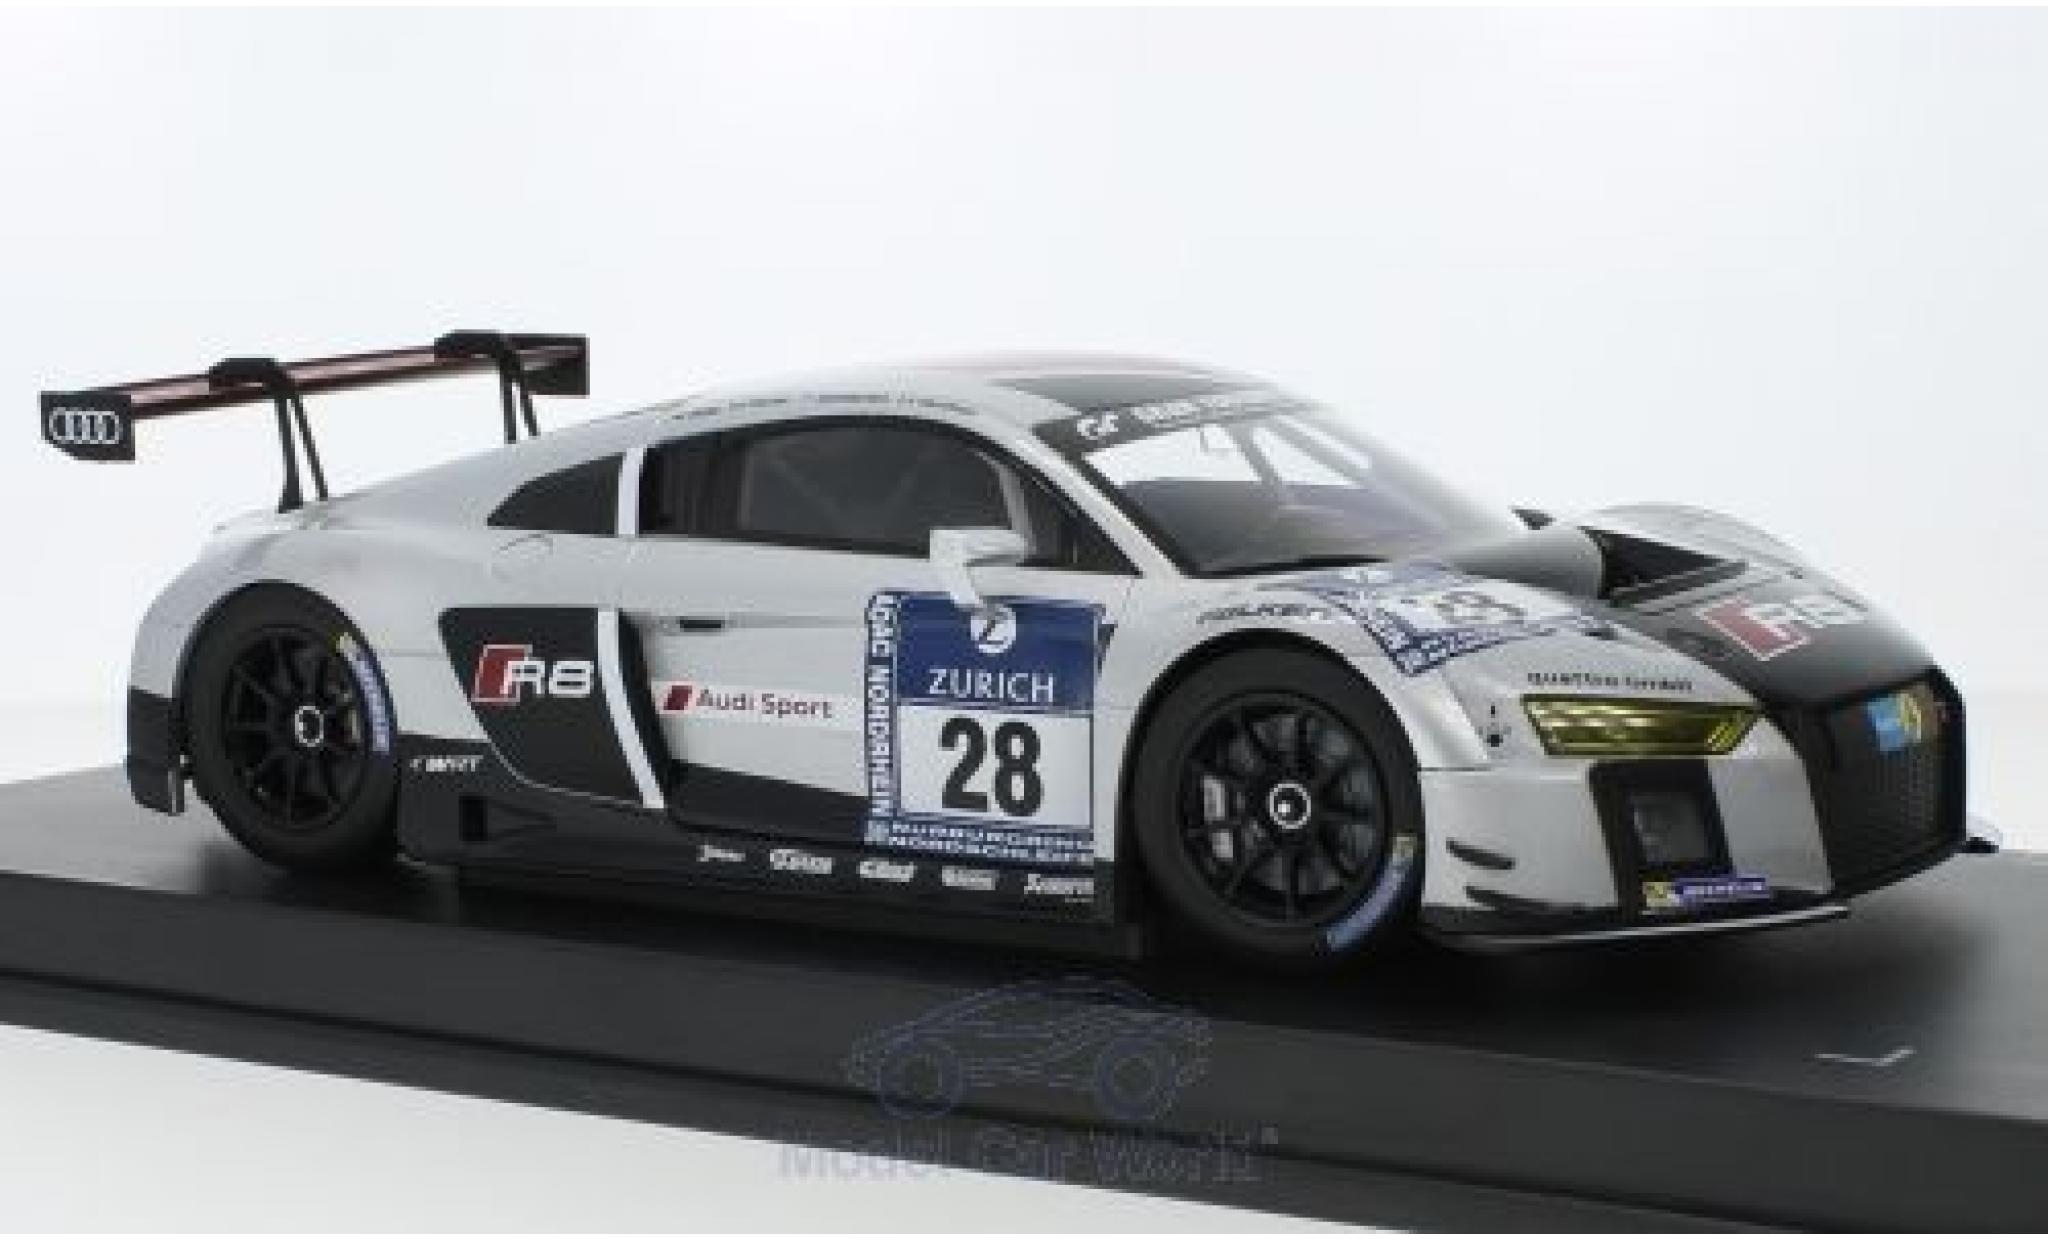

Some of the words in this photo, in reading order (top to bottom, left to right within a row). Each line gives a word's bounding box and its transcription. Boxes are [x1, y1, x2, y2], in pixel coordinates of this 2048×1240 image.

[870, 595, 895, 658] ADAC
[500, 657, 595, 698] R8
[696, 688, 755, 711] Audi
[762, 692, 833, 719] Sport
[927, 668, 1054, 703] ZURICH
[867, 664, 891, 818] NORDRHEIN
[938, 714, 1045, 818] 28
